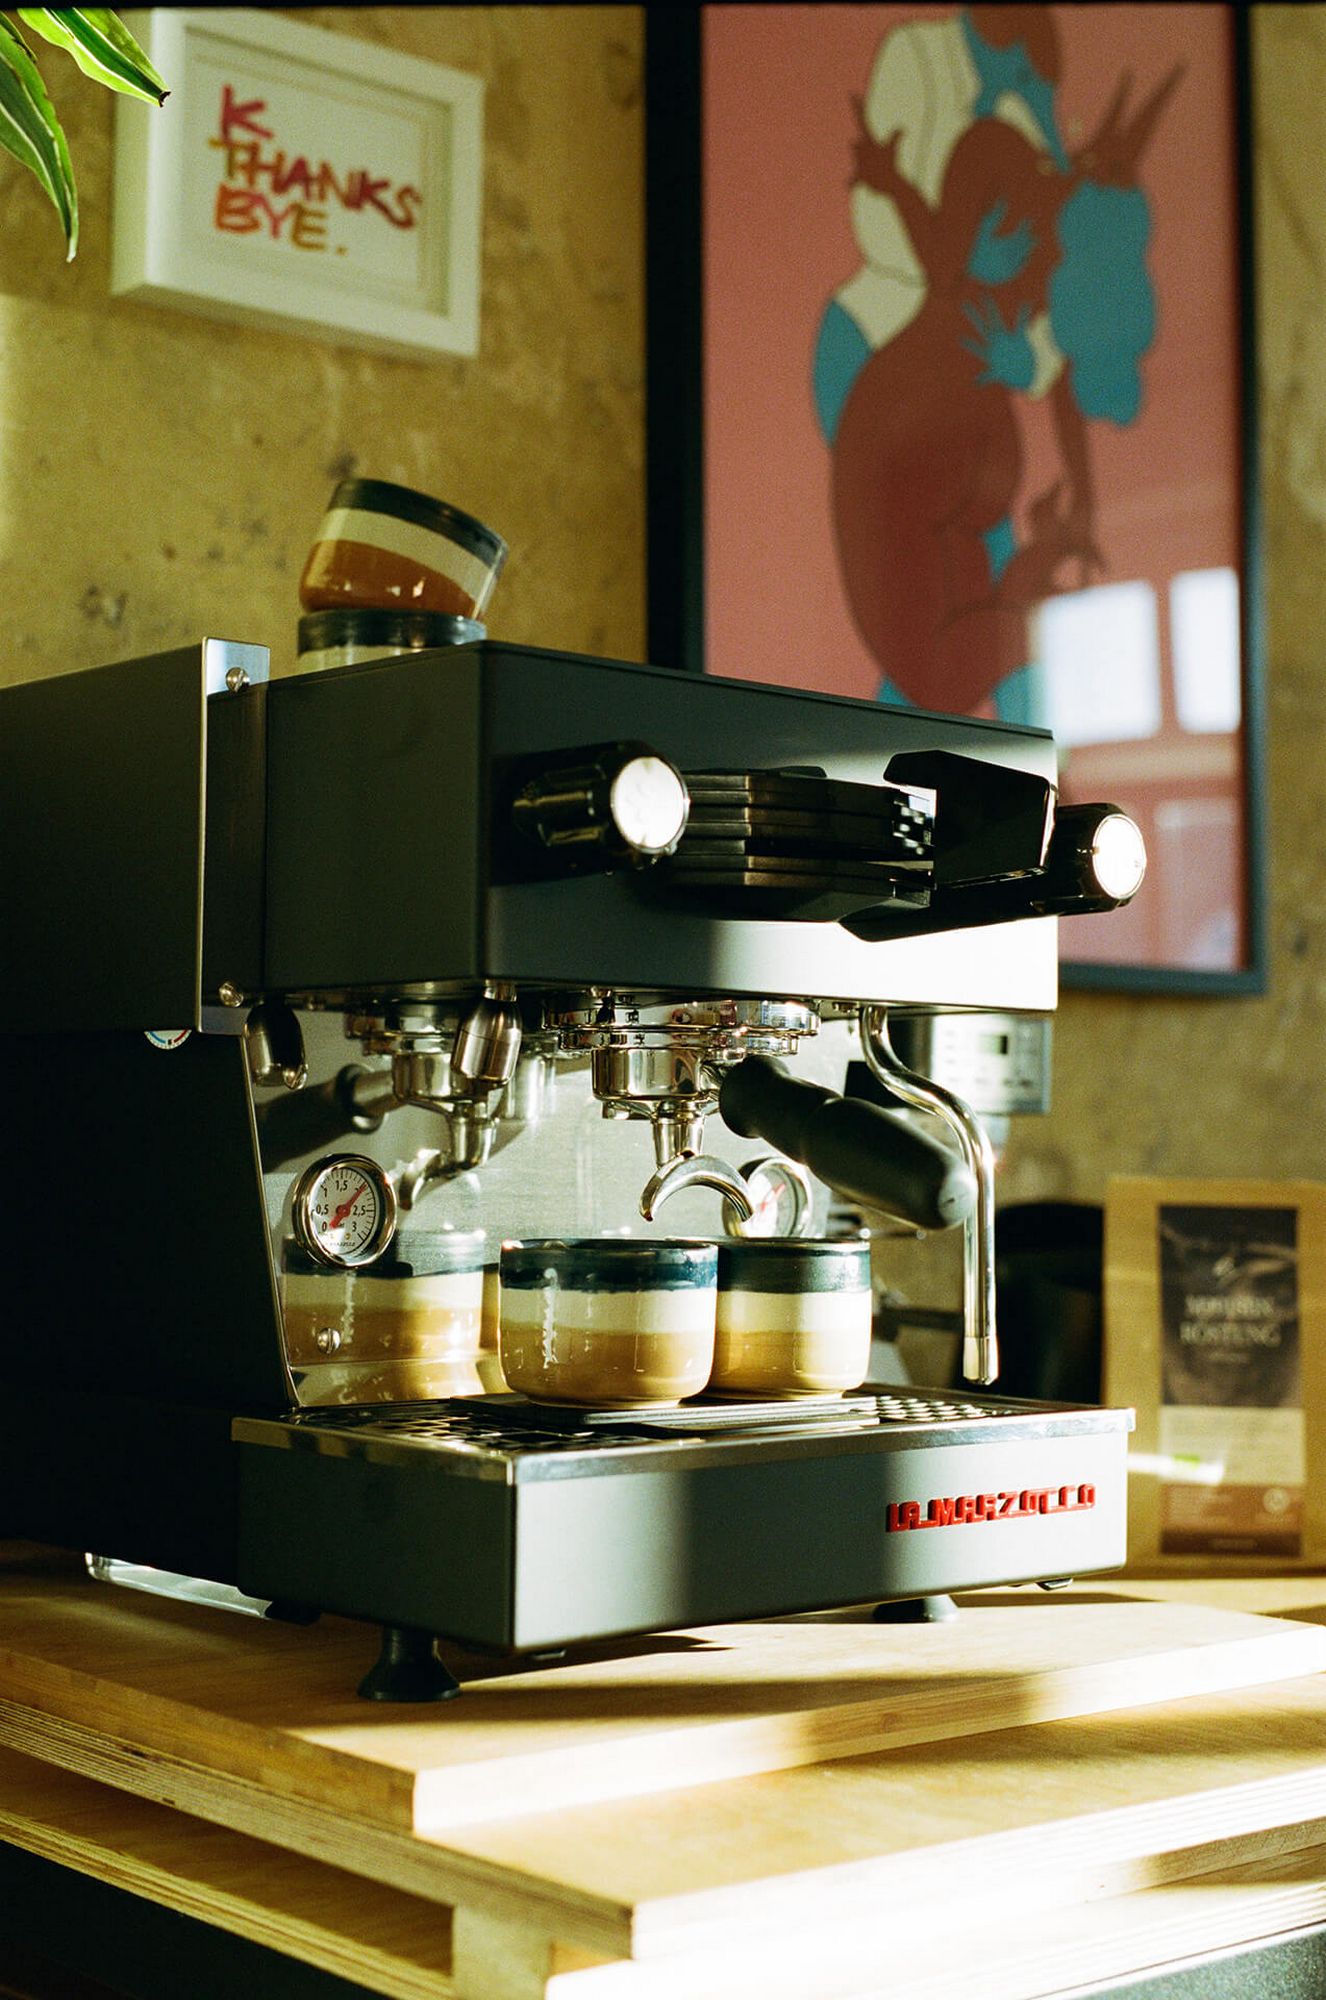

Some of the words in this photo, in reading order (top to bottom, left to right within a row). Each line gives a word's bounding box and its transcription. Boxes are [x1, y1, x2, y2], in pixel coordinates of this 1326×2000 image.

[220, 83, 275, 146] K
[208, 139, 423, 232] THANKS
[214, 183, 347, 255] BYE.
[335, 1180, 348, 1192] 1,5
[315, 1204, 329, 1216] 0,5
[352, 1205, 366, 1217] 2,5
[321, 1221, 327, 1232] 0
[352, 1221, 357, 1232] 3
[928, 1483, 1096, 1526] MARZOCCO
